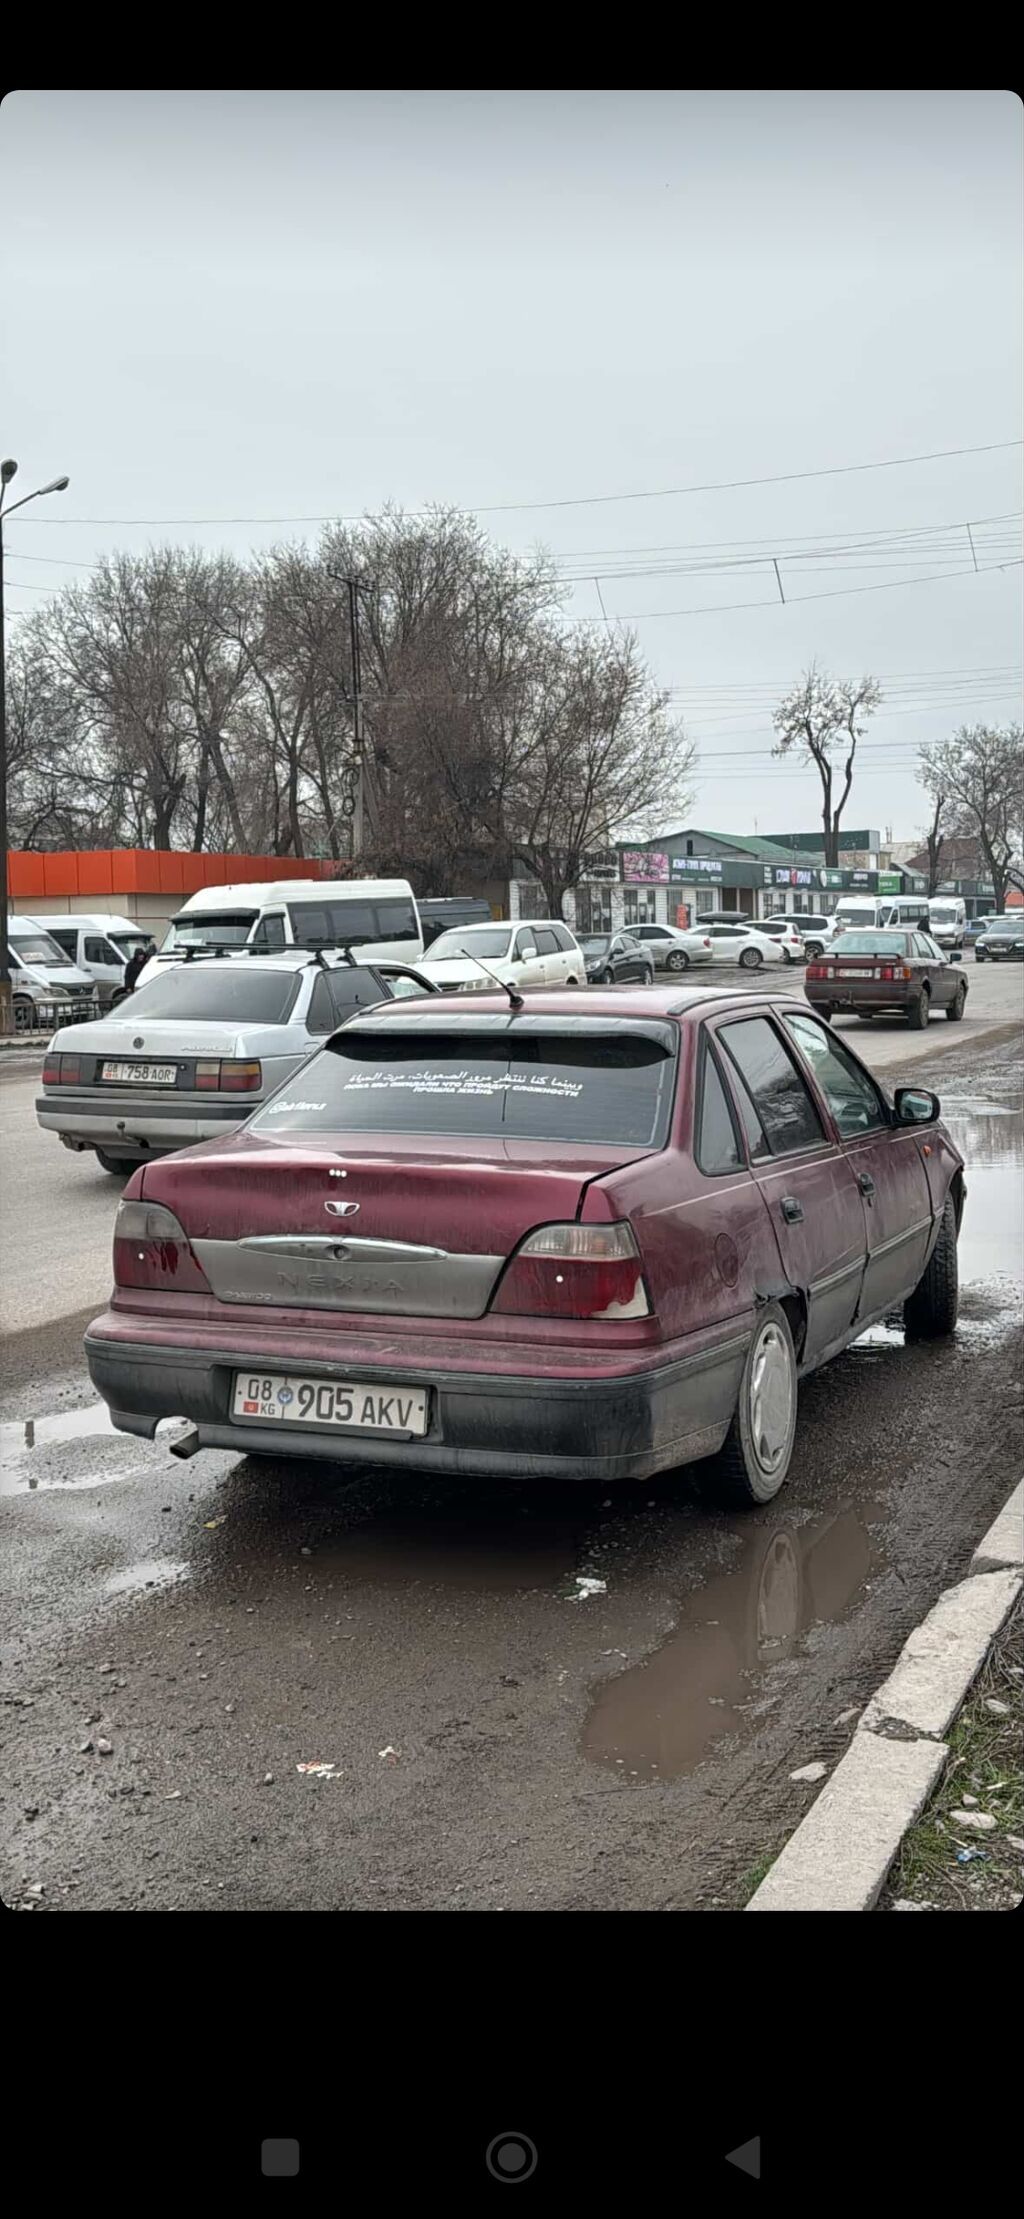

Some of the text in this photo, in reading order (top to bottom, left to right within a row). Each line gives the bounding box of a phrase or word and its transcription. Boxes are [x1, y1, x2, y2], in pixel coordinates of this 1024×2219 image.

[127, 1064, 150, 1080] 758
[530, 1075, 549, 1085] كنا
[457, 1087, 494, 1095] ЖИЗНЬ
[512, 1085, 580, 1097] СЛОЖНОСТИ
[247, 1379, 413, 1427] 08 905 AKV
[260, 1402, 276, 1416] KG
